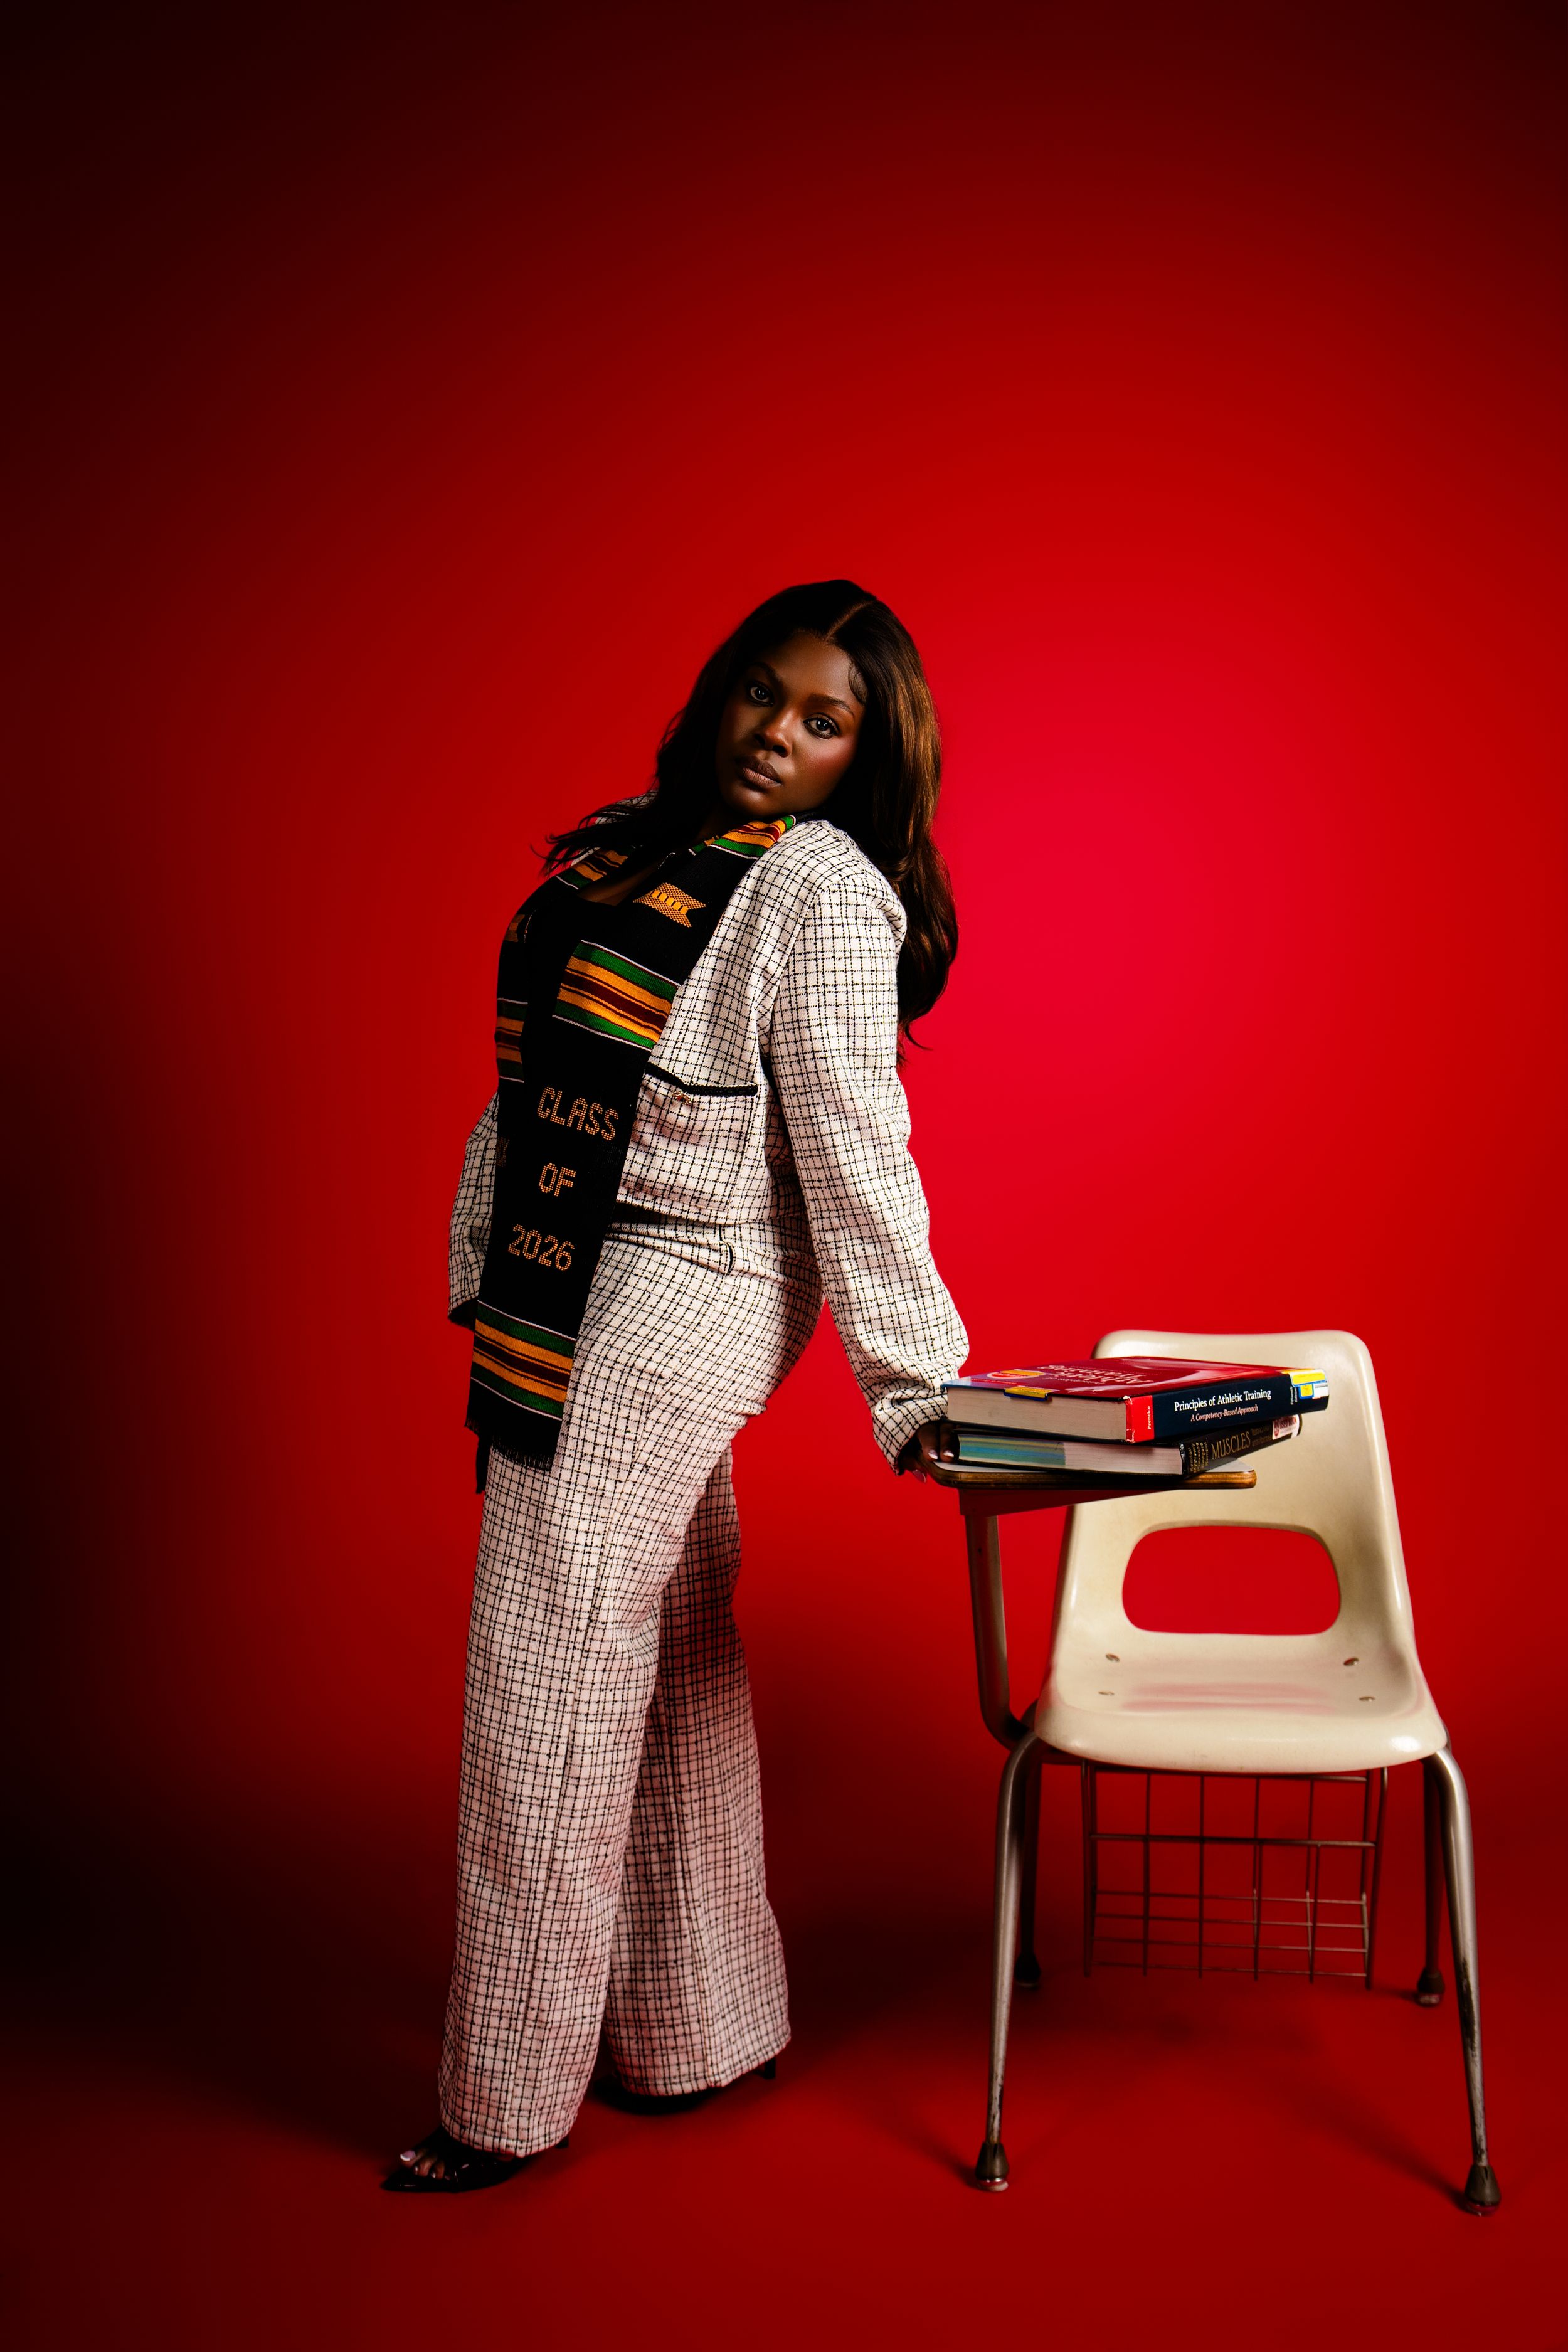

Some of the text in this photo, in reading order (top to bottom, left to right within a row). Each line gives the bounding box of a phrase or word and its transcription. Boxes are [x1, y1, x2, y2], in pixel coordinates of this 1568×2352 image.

[536, 1086, 620, 1142] CLASS
[538, 1162, 577, 1197] OF
[507, 1224, 576, 1271] 2026
[1174, 1389, 1272, 1412] Principles of Athletic Training
[1190, 1404, 1259, 1422] A Competency-Based Approach
[1211, 1431, 1251, 1461] MUSCLES
